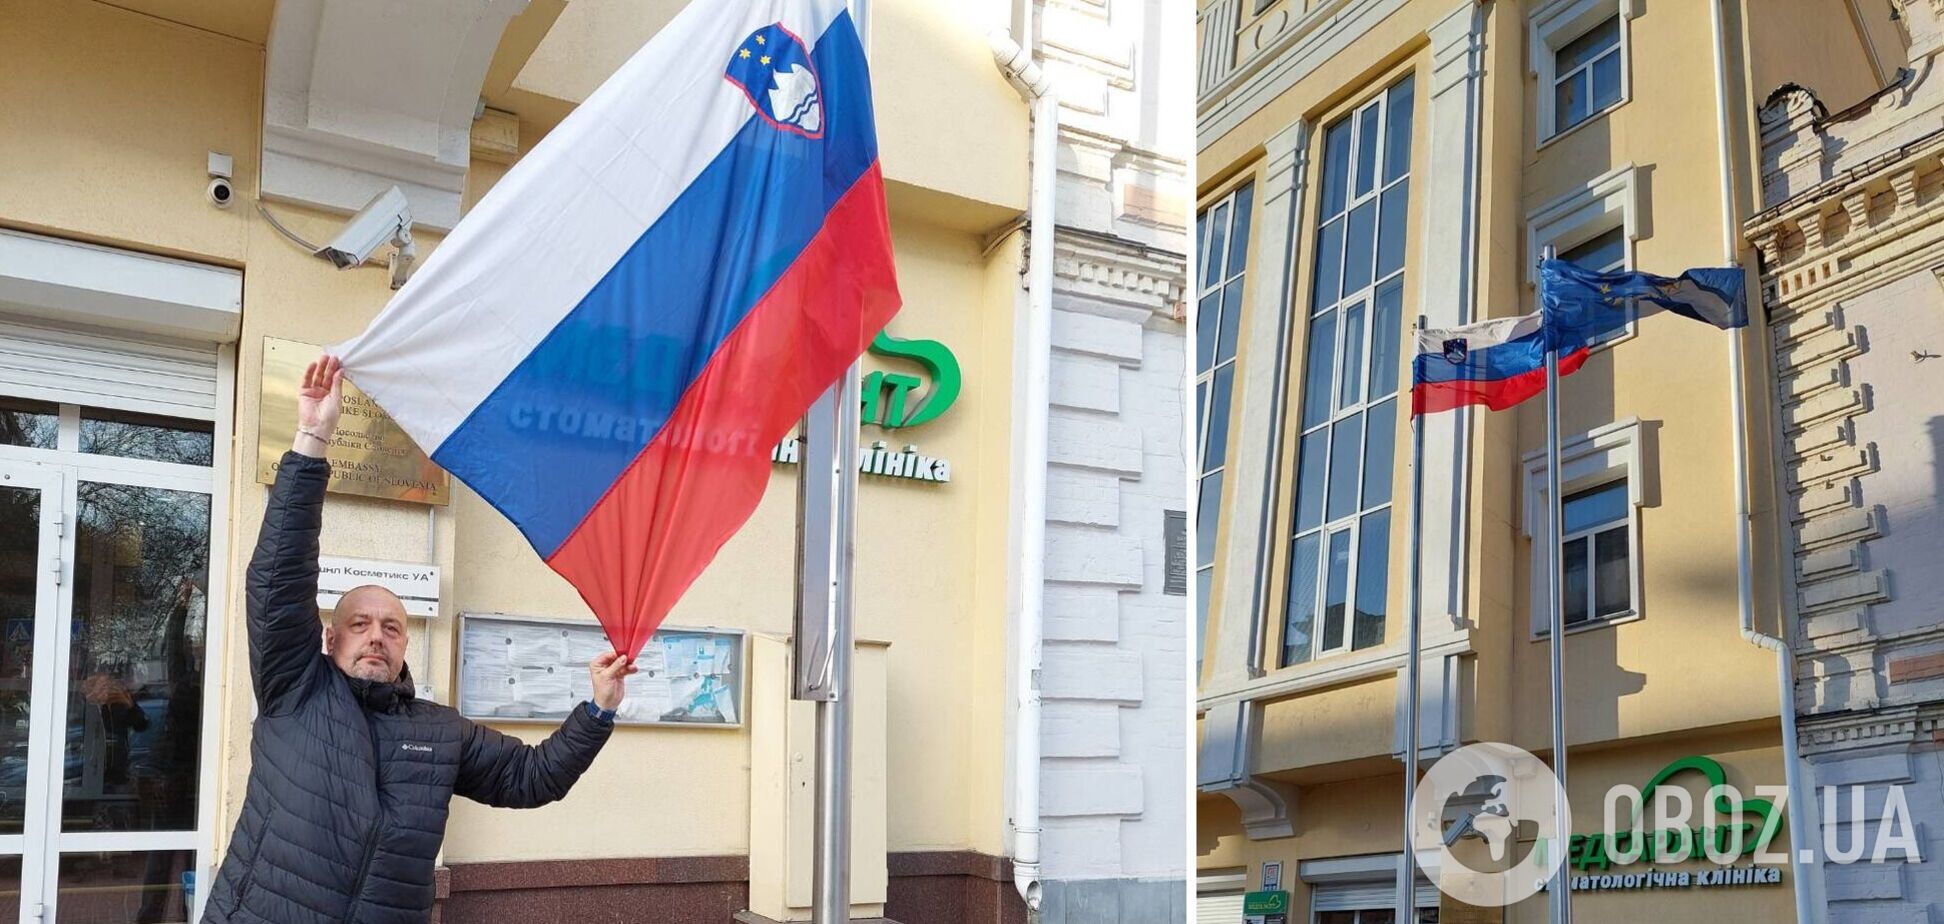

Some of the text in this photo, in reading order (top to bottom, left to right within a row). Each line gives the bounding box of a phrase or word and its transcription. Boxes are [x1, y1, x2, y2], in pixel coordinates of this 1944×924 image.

[342, 406, 360, 416] IKE
[332, 459, 380, 474] EMBASSY
[859, 440, 950, 482] лініка
[328, 470, 366, 483] PUBLIC
[368, 473, 382, 484] OF
[384, 474, 437, 491] SLOVENIA
[344, 566, 409, 581] Косметикс
[1533, 863, 1784, 891] сатологічна клініка
